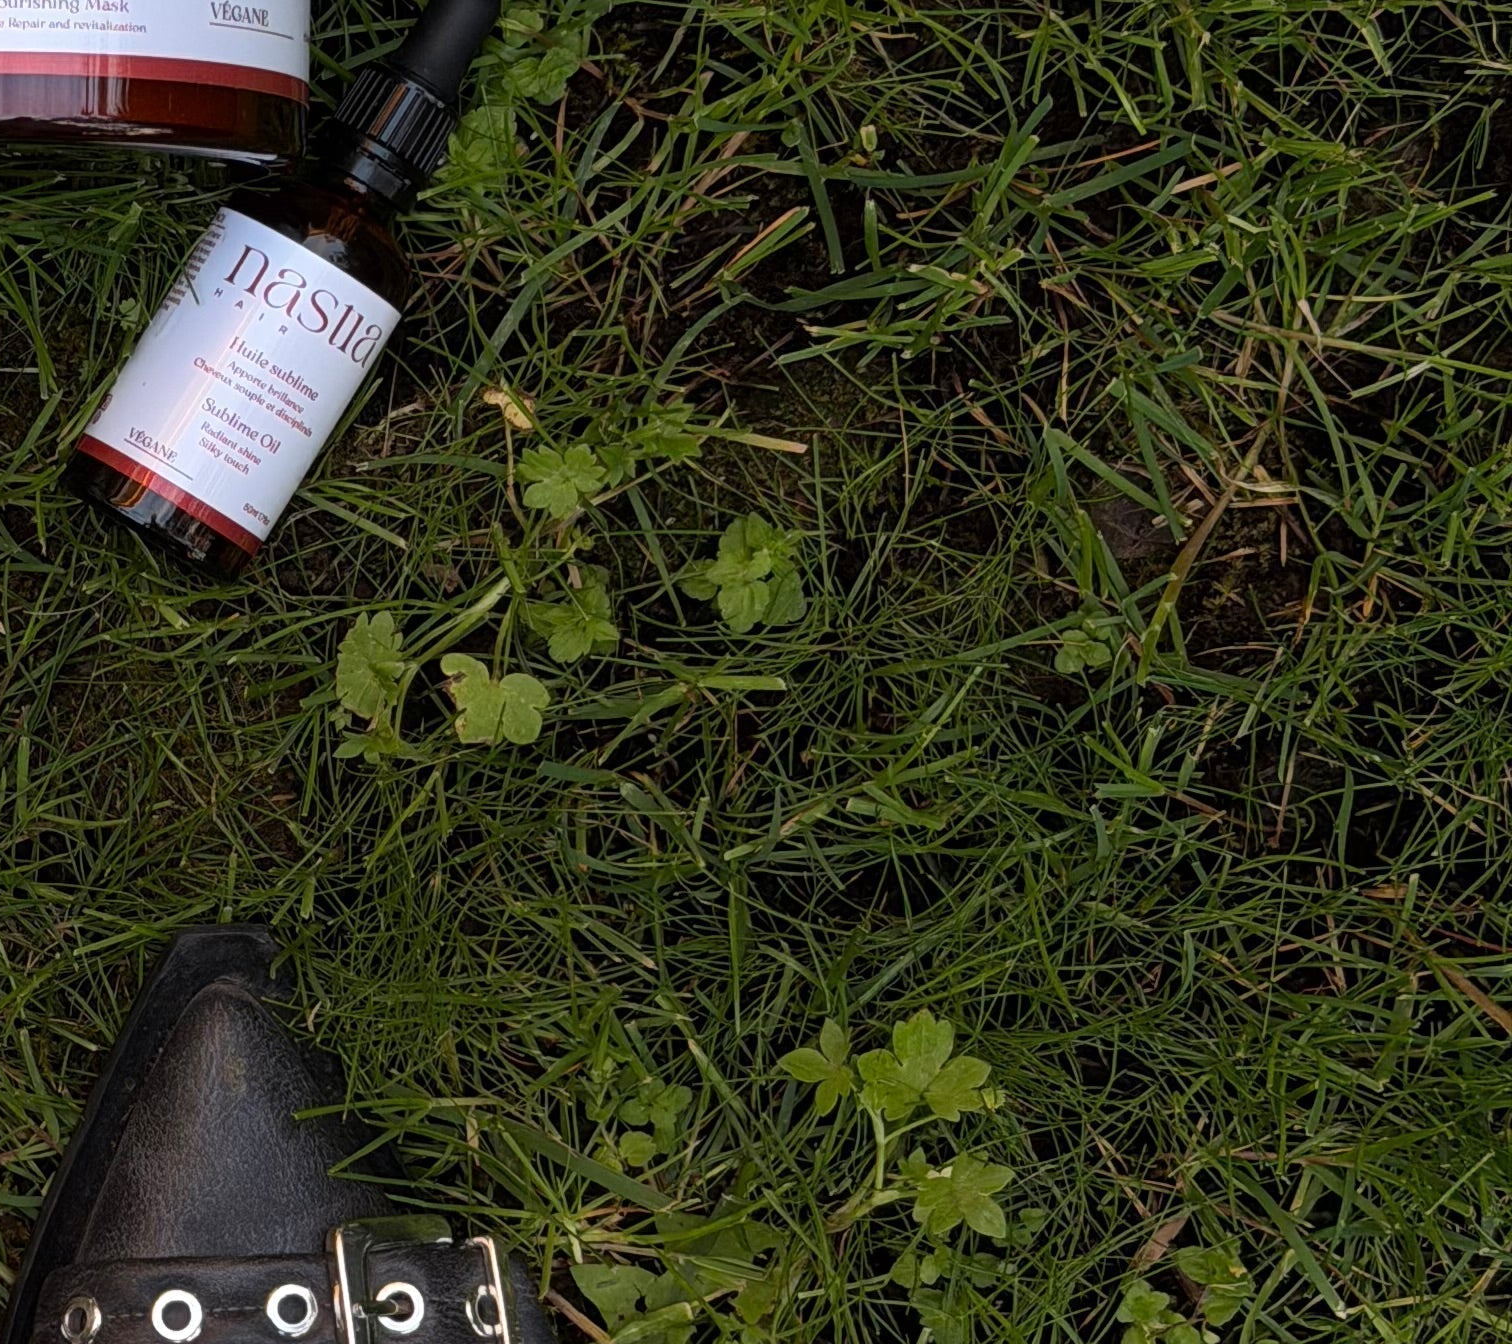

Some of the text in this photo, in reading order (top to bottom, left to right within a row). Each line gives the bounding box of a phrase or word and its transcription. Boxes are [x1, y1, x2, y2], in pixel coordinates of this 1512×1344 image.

[8, 17, 46, 31] Repair
[49, 18, 71, 30] and
[210, 0, 269, 27] VÉGANE
[193, 356, 233, 387] Cheveux
[233, 382, 265, 407] souple
[266, 401, 275, 413] et
[227, 360, 267, 390] Apporte
[229, 336, 319, 401] Huile sublime
[129, 427, 178, 464] VÉGANE
[200, 420, 262, 466] Radiant shine
[201, 397, 282, 455] Sublime Oil
[198, 436, 250, 475] Silky touch
